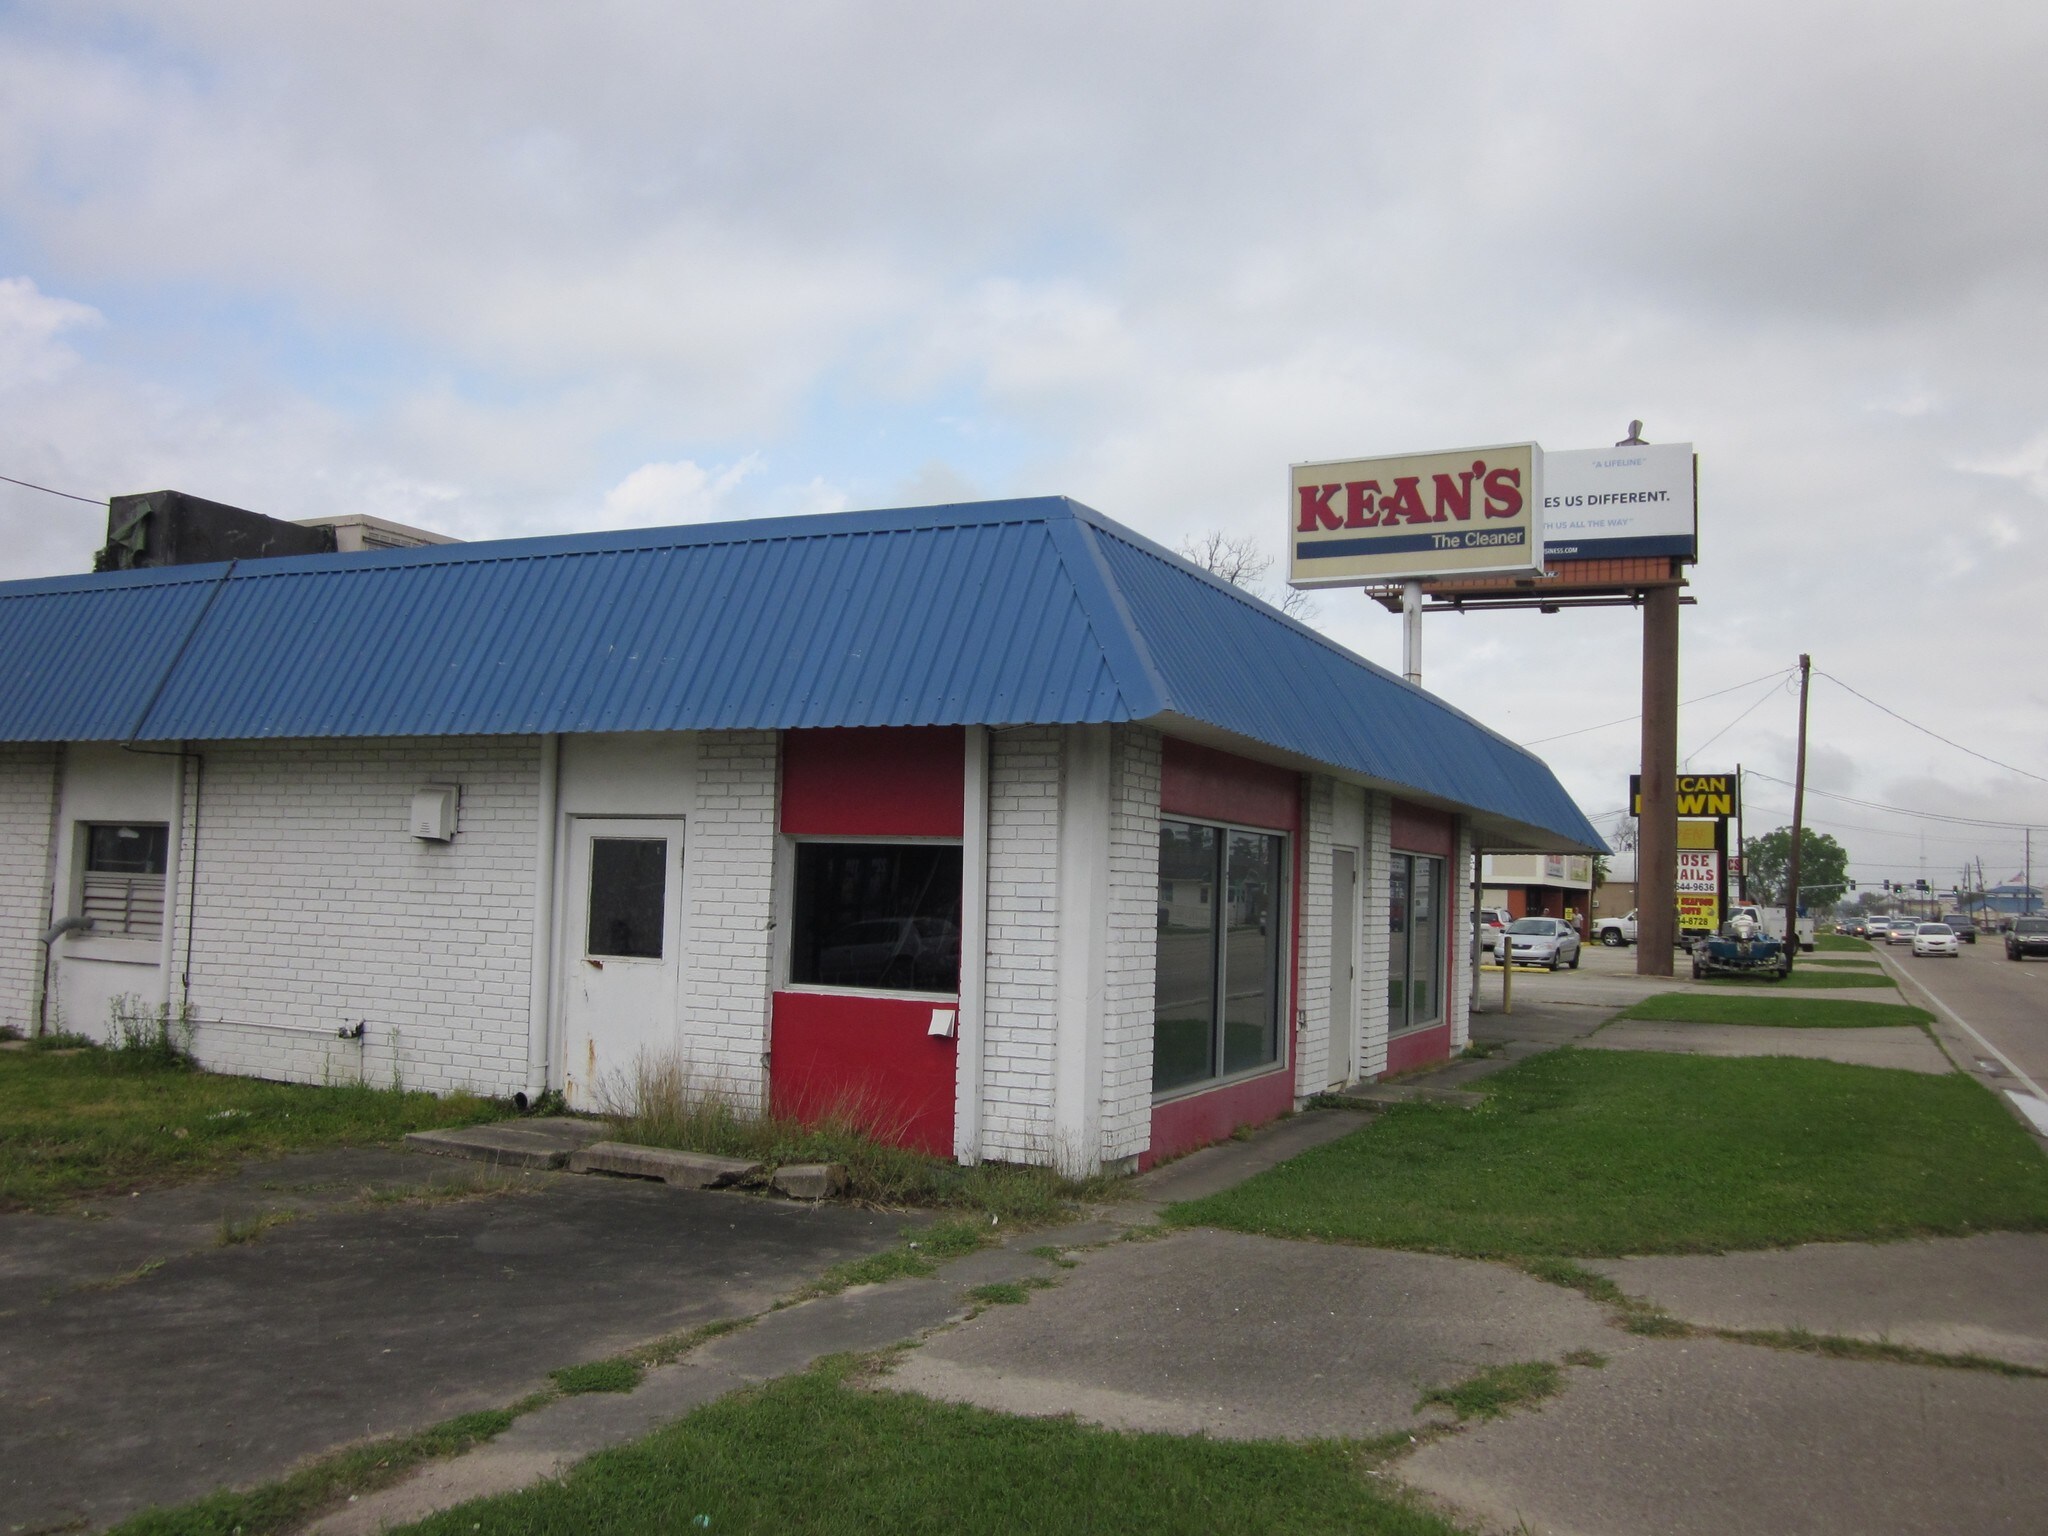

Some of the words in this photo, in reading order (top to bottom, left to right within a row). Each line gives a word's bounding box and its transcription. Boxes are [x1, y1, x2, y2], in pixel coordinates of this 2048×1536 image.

[1297, 460, 1523, 532] KEAN'S
[1565, 495, 1584, 507] US
[1587, 490, 1671, 506] DIFFERENT.
[1556, 520, 1567, 529] US
[1569, 519, 1585, 529] ALL
[1588, 519, 1605, 528] THE
[1432, 534, 1461, 549] The
[1464, 530, 1524, 548] Cleaner
